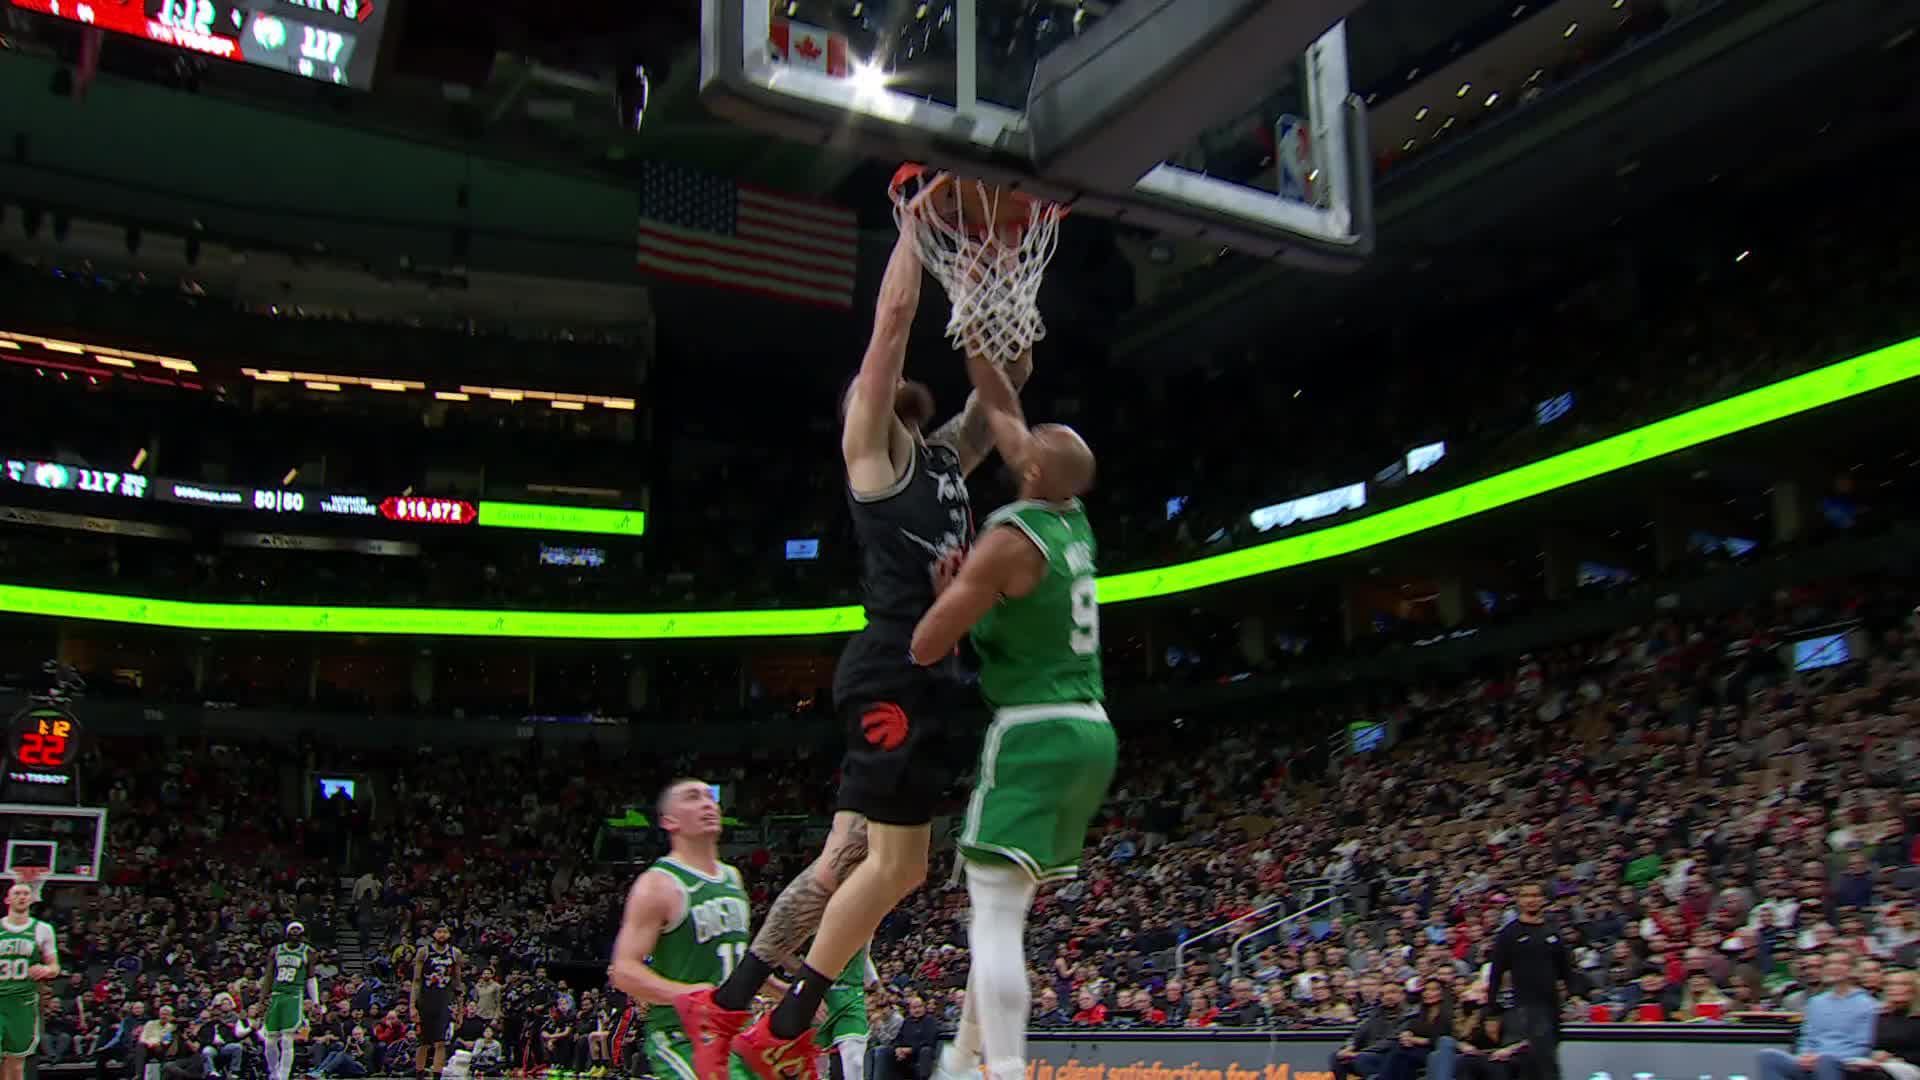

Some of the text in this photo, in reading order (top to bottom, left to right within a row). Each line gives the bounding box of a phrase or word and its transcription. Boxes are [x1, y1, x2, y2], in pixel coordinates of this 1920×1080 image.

[79, 469, 119, 493] 117
[1070, 577, 1100, 656] 9
[19, 733, 66, 766] 22
